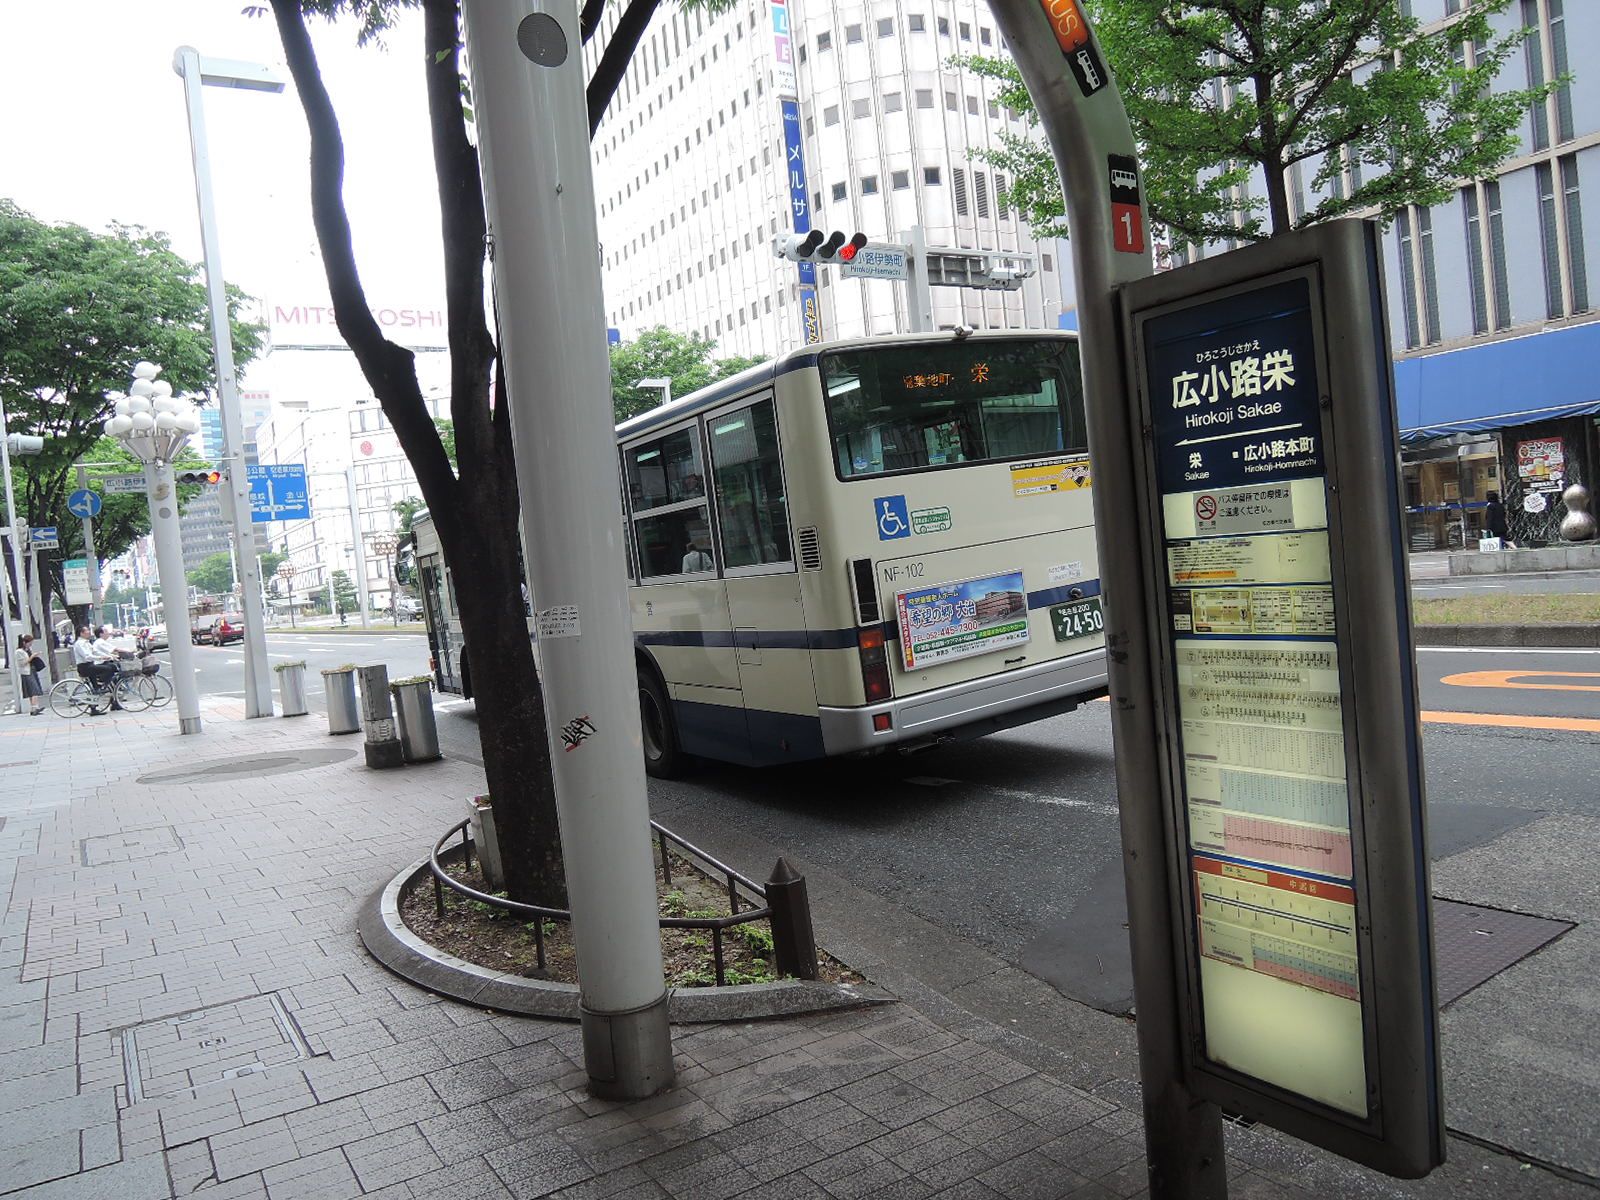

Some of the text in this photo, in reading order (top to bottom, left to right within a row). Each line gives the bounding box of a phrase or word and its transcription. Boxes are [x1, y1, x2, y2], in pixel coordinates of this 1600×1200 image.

[1048, 0, 1078, 36] US
[789, 144, 806, 216] メルサ
[1120, 212, 1132, 245] 1
[858, 250, 903, 267] 小路伊勢町
[275, 305, 443, 328] MITSOSHI
[1196, 340, 1261, 363] ひろこうじさかえ
[970, 362, 990, 383] 栄
[1172, 349, 1296, 408] 広小路栄
[1185, 401, 1282, 428] Hirokoji Sakae
[1189, 452, 1203, 469] 栄
[1243, 437, 1314, 461] 広小路本町
[1184, 471, 1210, 481] Sakae
[884, 562, 925, 582] NF-102
[910, 604, 953, 628] 希望の郷
